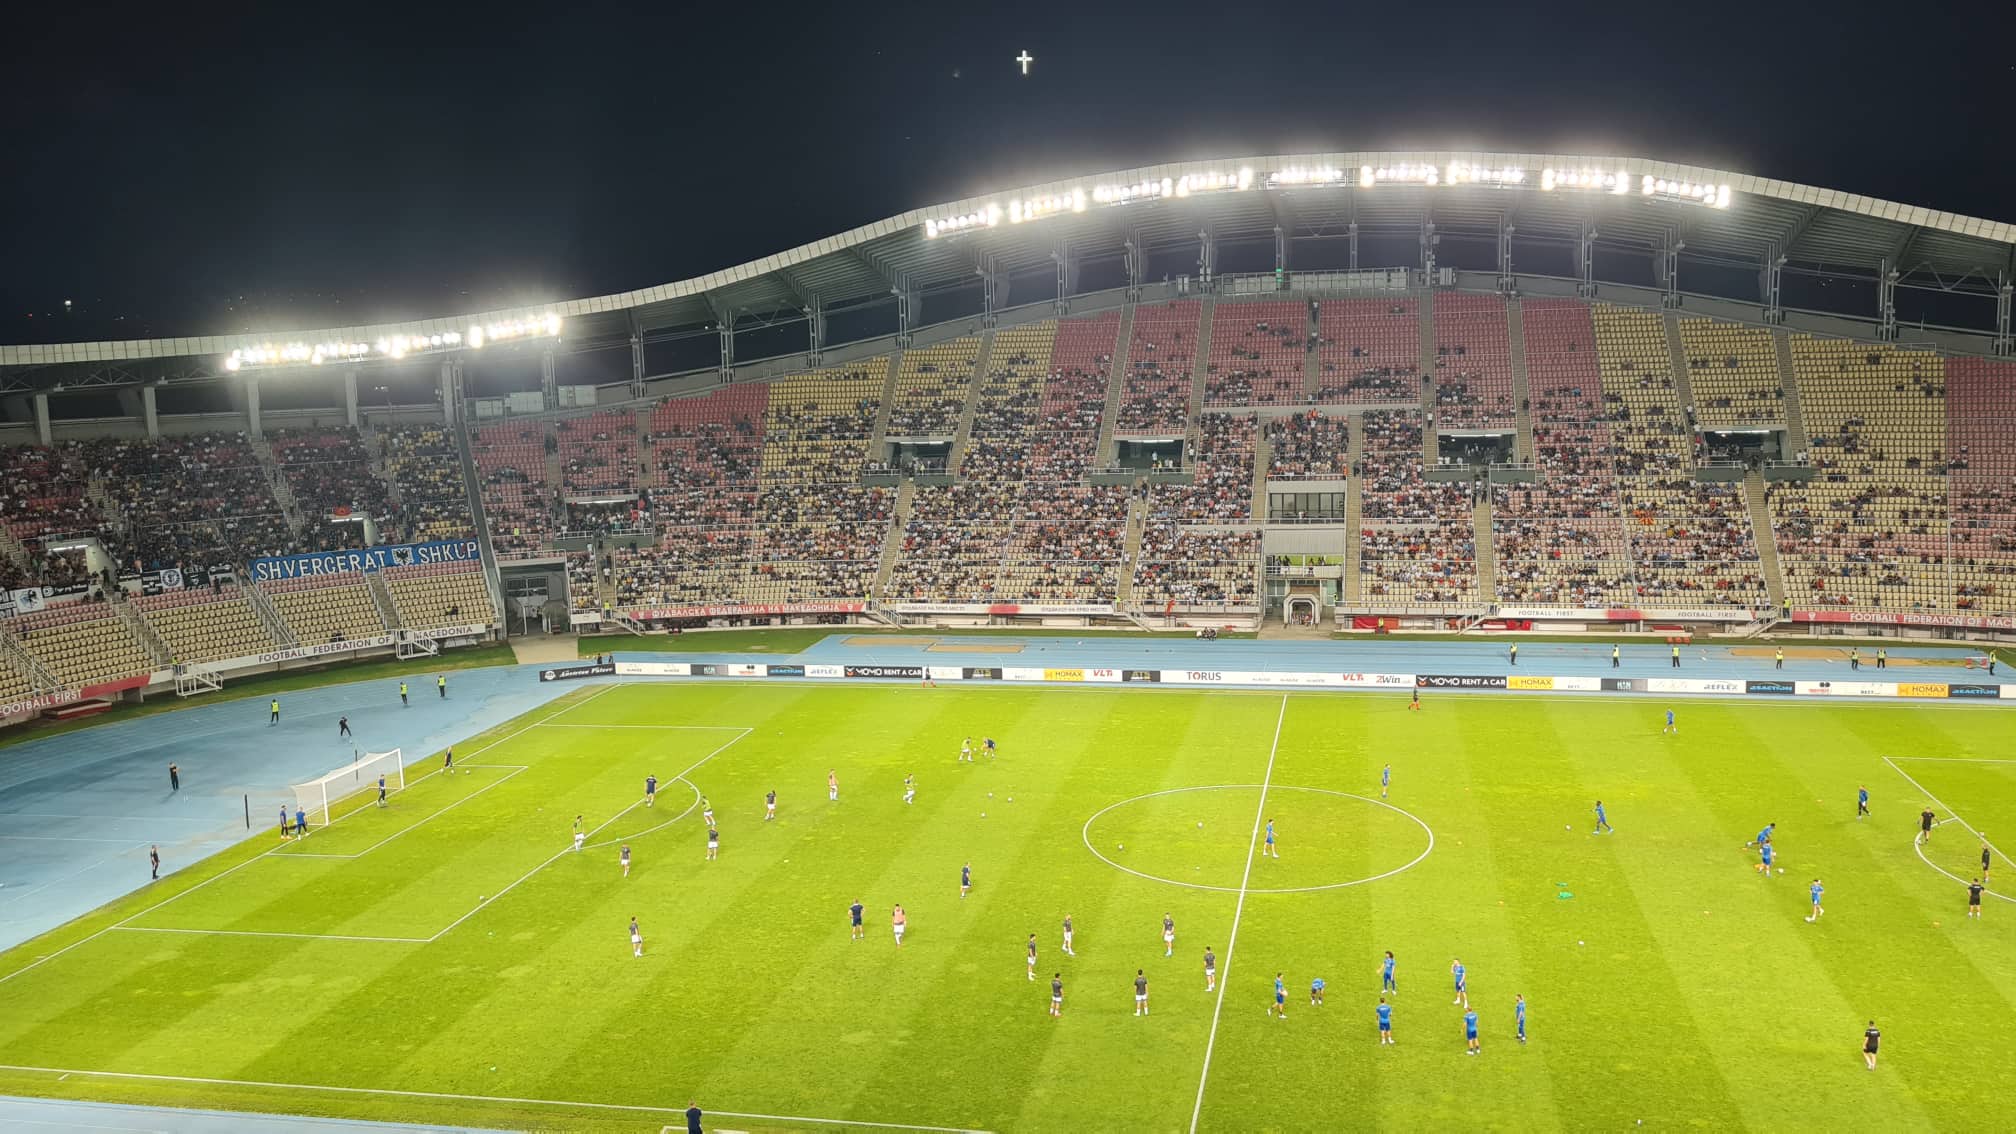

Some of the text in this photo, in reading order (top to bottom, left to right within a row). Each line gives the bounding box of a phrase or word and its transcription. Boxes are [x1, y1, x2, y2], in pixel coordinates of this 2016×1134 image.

[256, 541, 477, 582] SHVERCERAT SHKUP
[1718, 611, 1737, 619] FIRST
[1849, 612, 1898, 623] FOOTBALL
[1903, 614, 1963, 626] FEDERATION
[1967, 617, 1983, 626] OF
[258, 626, 473, 664] FOOTBALL FEDERATION OF MACEDONIA
[884, 668, 900, 676] RENT
[1187, 671, 1222, 681] TORUS
[1462, 678, 1481, 686] RENT
[1912, 685, 1945, 693] HOMAX
[0, 690, 81, 717] OOTBALL FIRST
